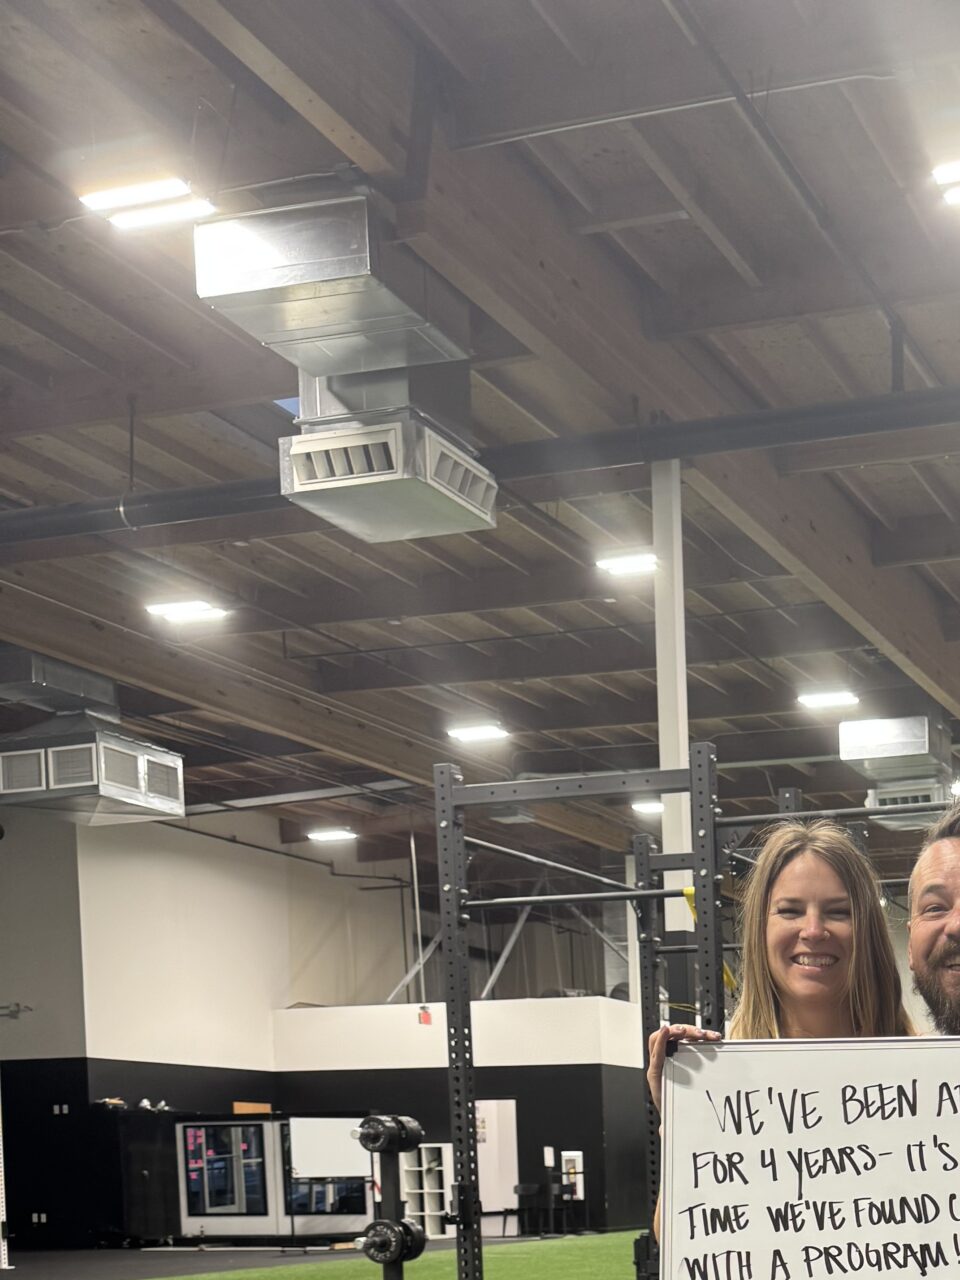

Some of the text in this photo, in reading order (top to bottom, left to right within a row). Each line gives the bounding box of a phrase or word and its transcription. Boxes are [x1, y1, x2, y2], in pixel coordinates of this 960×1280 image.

[706, 1086, 823, 1135] WE'VE
[841, 1079, 917, 1125] BEEN
[692, 1151, 749, 1189] FOR
[760, 1148, 778, 1182] 4
[906, 1134, 959, 1172] IT'S
[678, 1203, 750, 1240] TIME
[766, 1200, 846, 1233] WE'VE
[853, 1193, 940, 1228] FOUND
[771, 1249, 791, 1280] A
